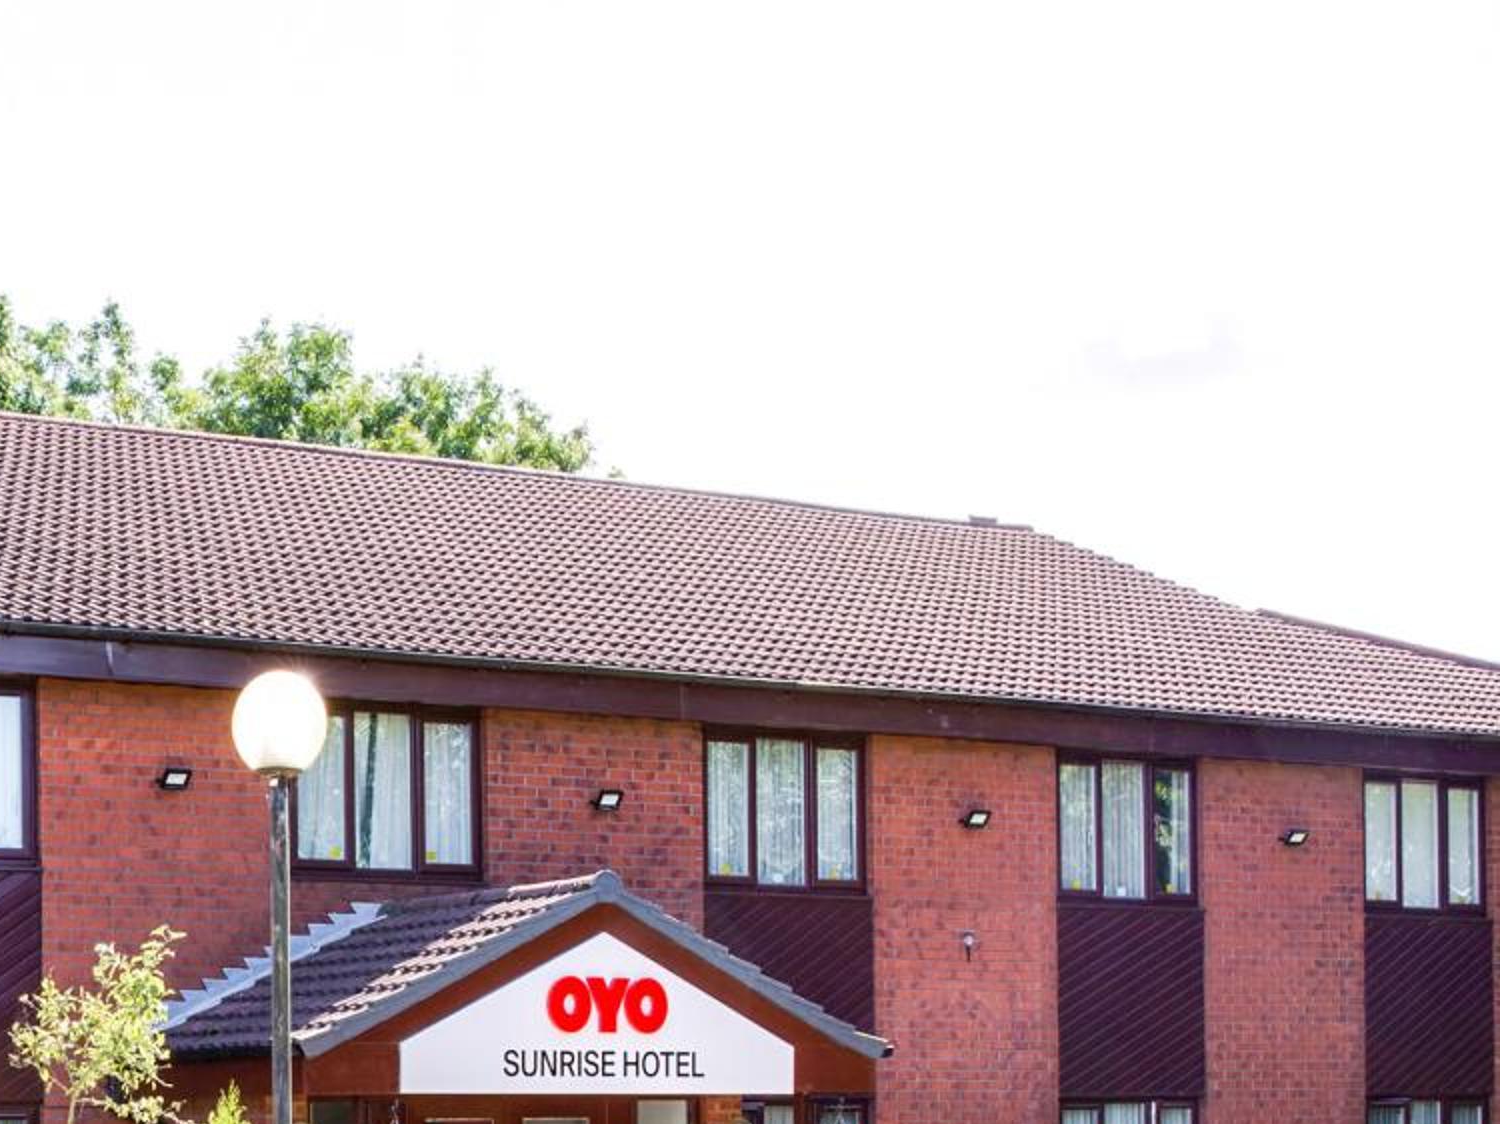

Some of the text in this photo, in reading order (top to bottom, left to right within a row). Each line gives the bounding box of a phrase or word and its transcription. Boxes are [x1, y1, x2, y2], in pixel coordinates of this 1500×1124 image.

[546, 975, 669, 1035] OYO
[503, 1049, 705, 1078] SUNRISE HOTEL
